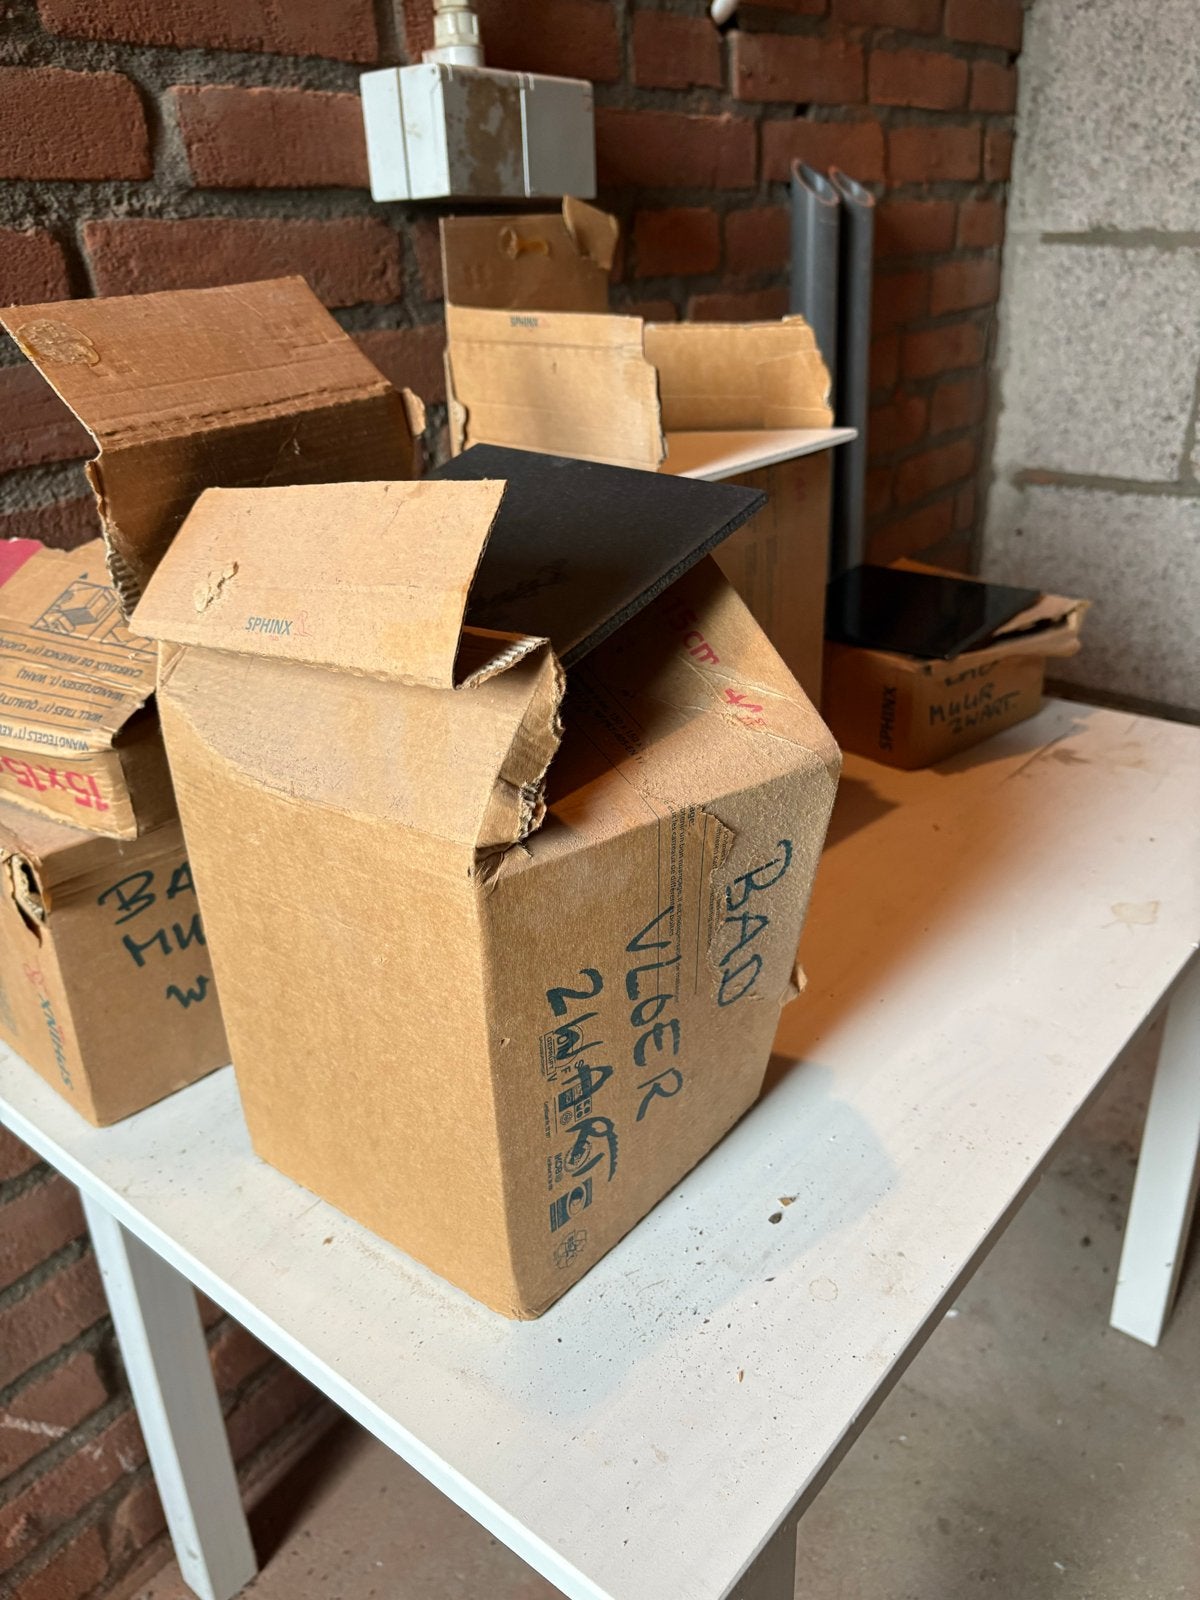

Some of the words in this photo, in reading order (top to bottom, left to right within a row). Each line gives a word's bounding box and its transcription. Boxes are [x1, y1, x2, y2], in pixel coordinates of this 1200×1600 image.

[245, 616, 294, 636] SPHINX
[28, 730, 90, 751] WANDTEGELS
[54, 705, 76, 718] TILES
[879, 686, 897, 752] SPHINX
[97, 860, 198, 925] BA
[122, 913, 209, 967] MU
[717, 838, 793, 1007] BAD
[38, 992, 75, 1091] SPHINX
